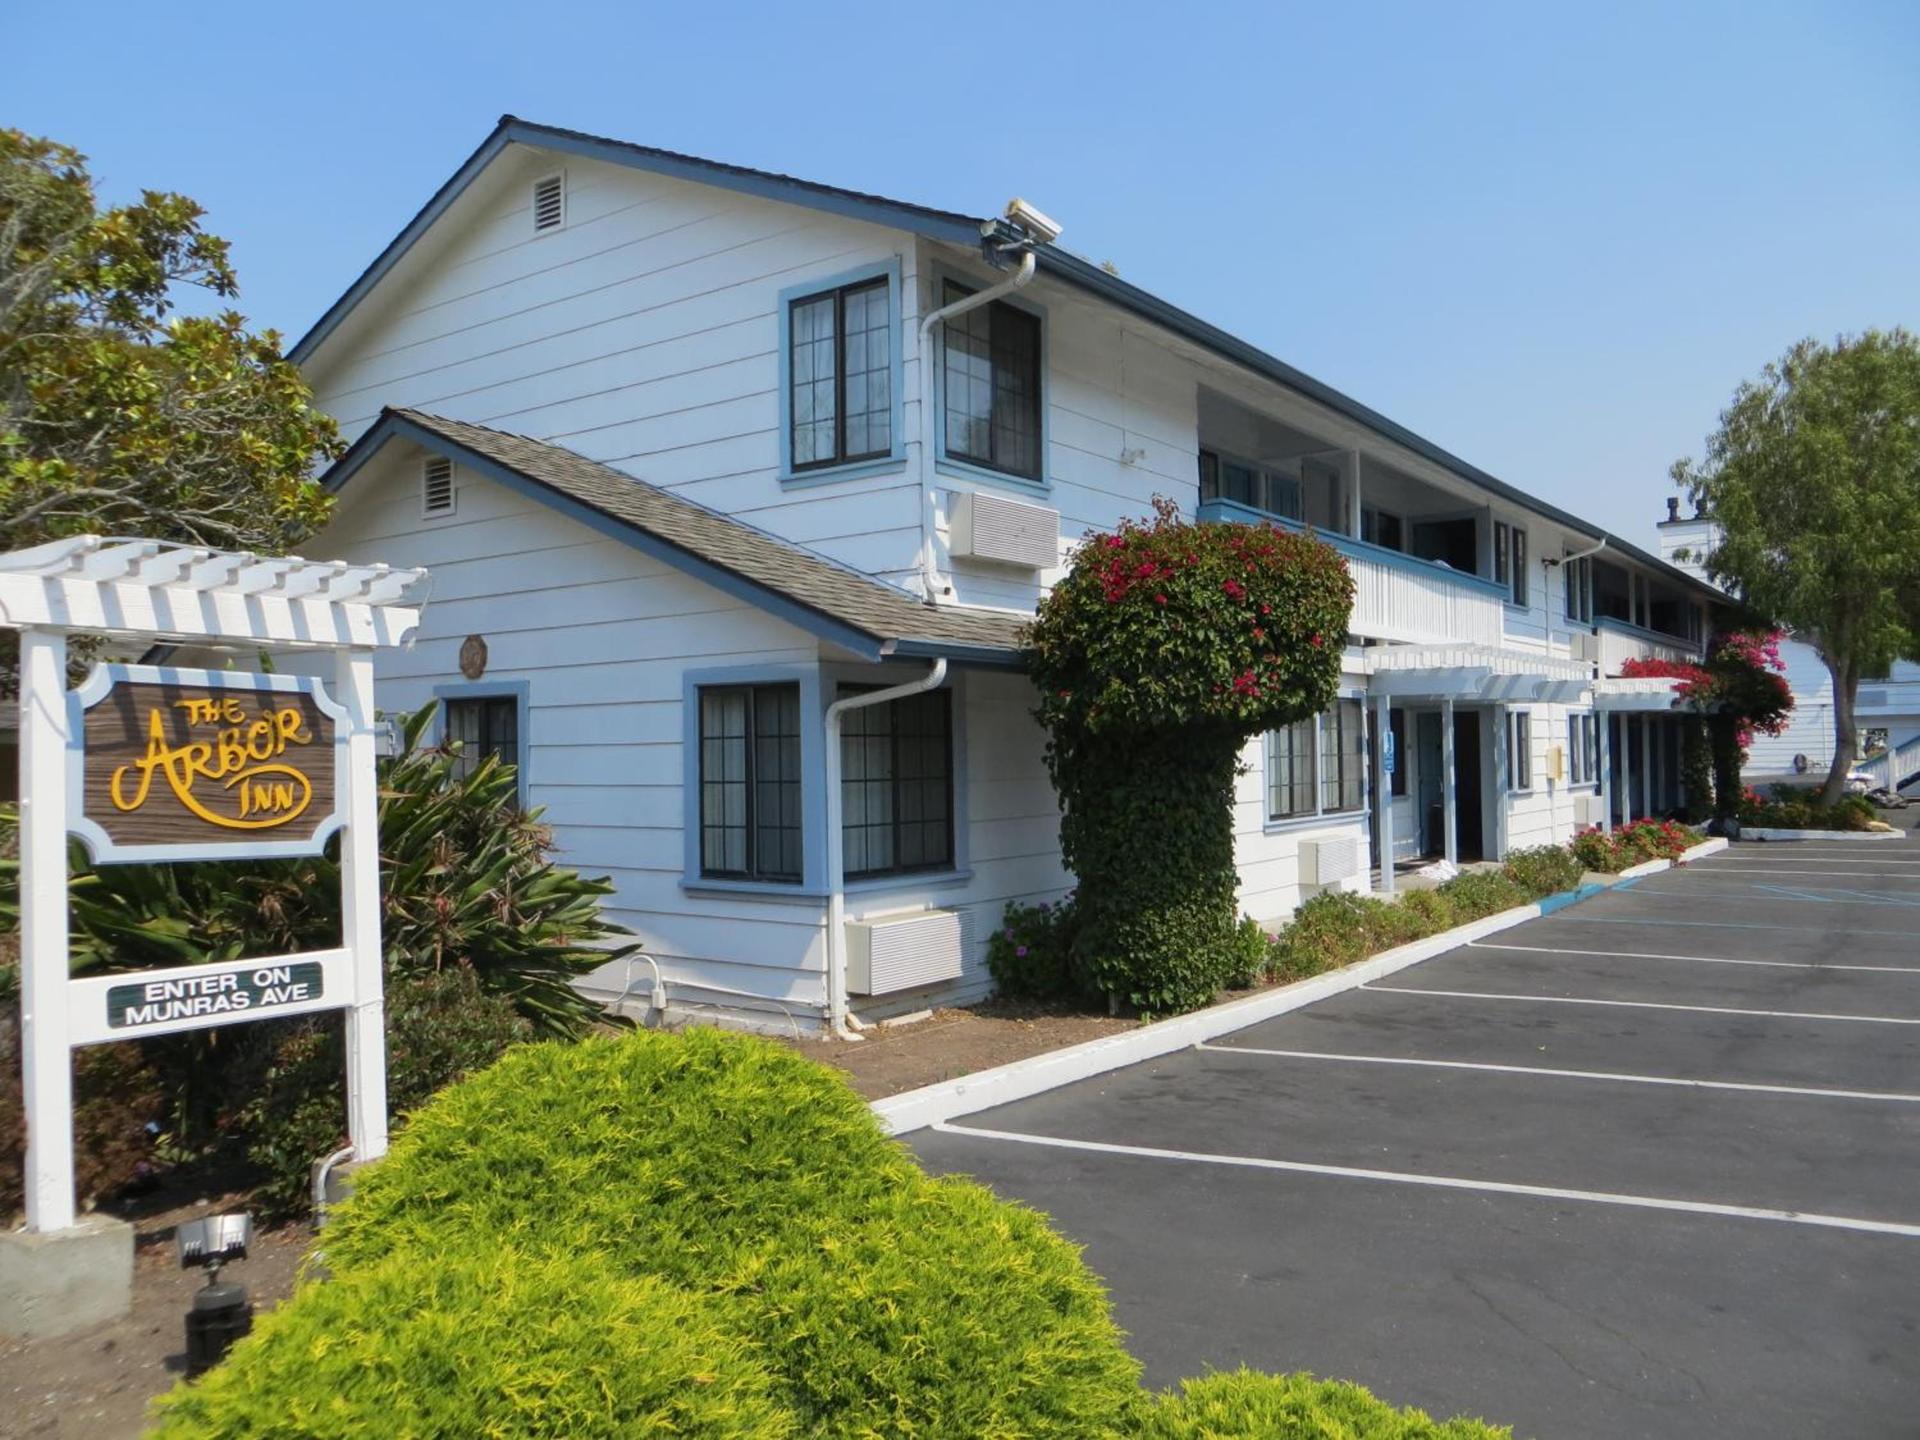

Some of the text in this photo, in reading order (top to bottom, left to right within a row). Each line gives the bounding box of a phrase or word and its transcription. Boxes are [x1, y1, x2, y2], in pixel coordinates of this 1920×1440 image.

[174, 698, 245, 726] THE
[111, 708, 312, 818] ARBOR
[237, 777, 294, 819] INN
[125, 983, 309, 1025] MUNRAS AVE
[145, 967, 292, 1002] ENTER ON
